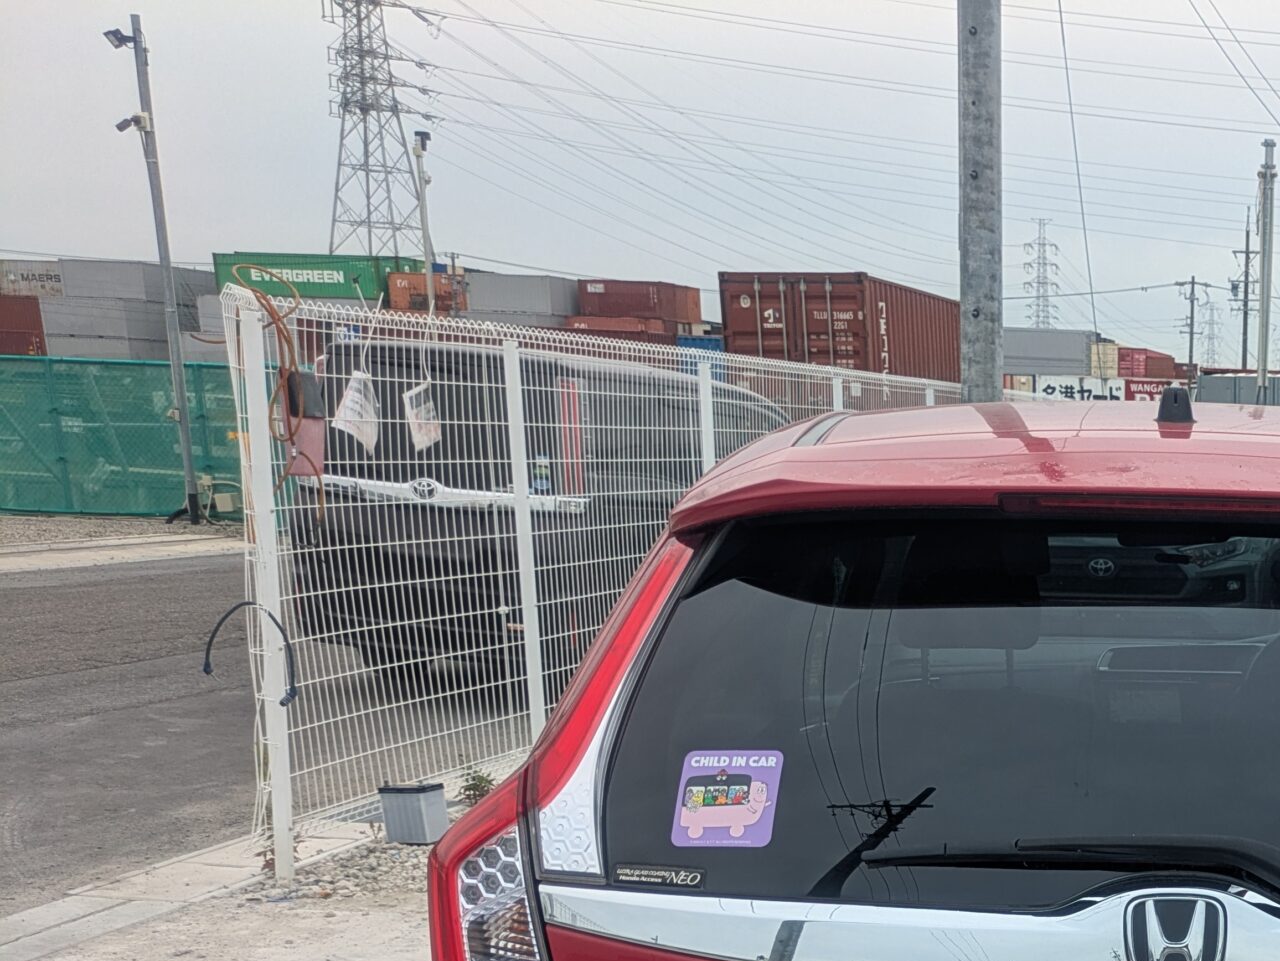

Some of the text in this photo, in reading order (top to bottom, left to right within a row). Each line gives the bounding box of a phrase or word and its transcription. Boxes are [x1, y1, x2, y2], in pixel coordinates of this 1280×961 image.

[251, 268, 345, 284] EVERGREEN
[691, 756, 777, 767] CHILD IN CAR
[666, 870, 701, 885] NEO
